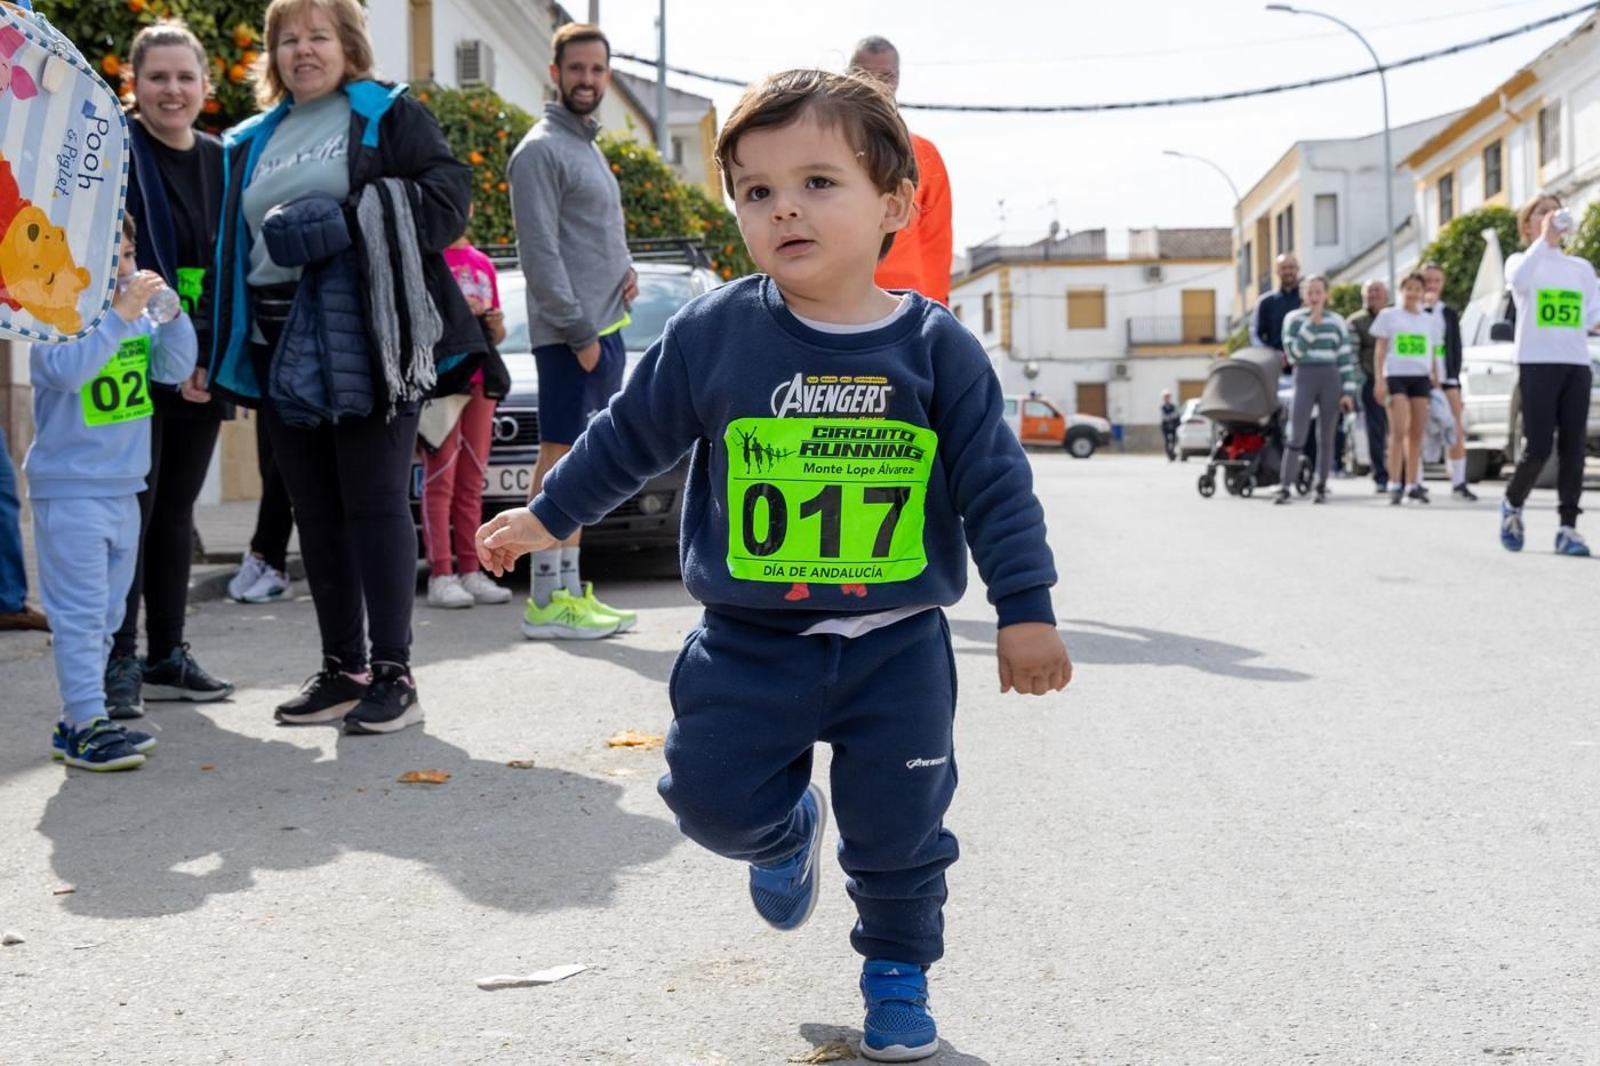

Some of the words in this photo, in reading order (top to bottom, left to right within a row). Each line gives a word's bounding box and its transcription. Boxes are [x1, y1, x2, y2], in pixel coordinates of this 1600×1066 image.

[78, 113, 109, 189] Pooh
[56, 144, 79, 195] Piglet
[1542, 304, 1581, 322] 057
[91, 370, 145, 412] 02
[770, 373, 893, 419] AVENGERS
[811, 426, 917, 442] CIRCUITO
[798, 442, 924, 462] RUNNING
[500, 468, 530, 491] CC
[803, 462, 842, 475] Monte
[846, 463, 875, 478] Lope
[877, 462, 914, 475] Álvarez
[742, 482, 912, 558] 017
[763, 563, 785, 577] DÍA
[789, 566, 807, 578] DE
[810, 564, 882, 578] ANDALUCÍA
